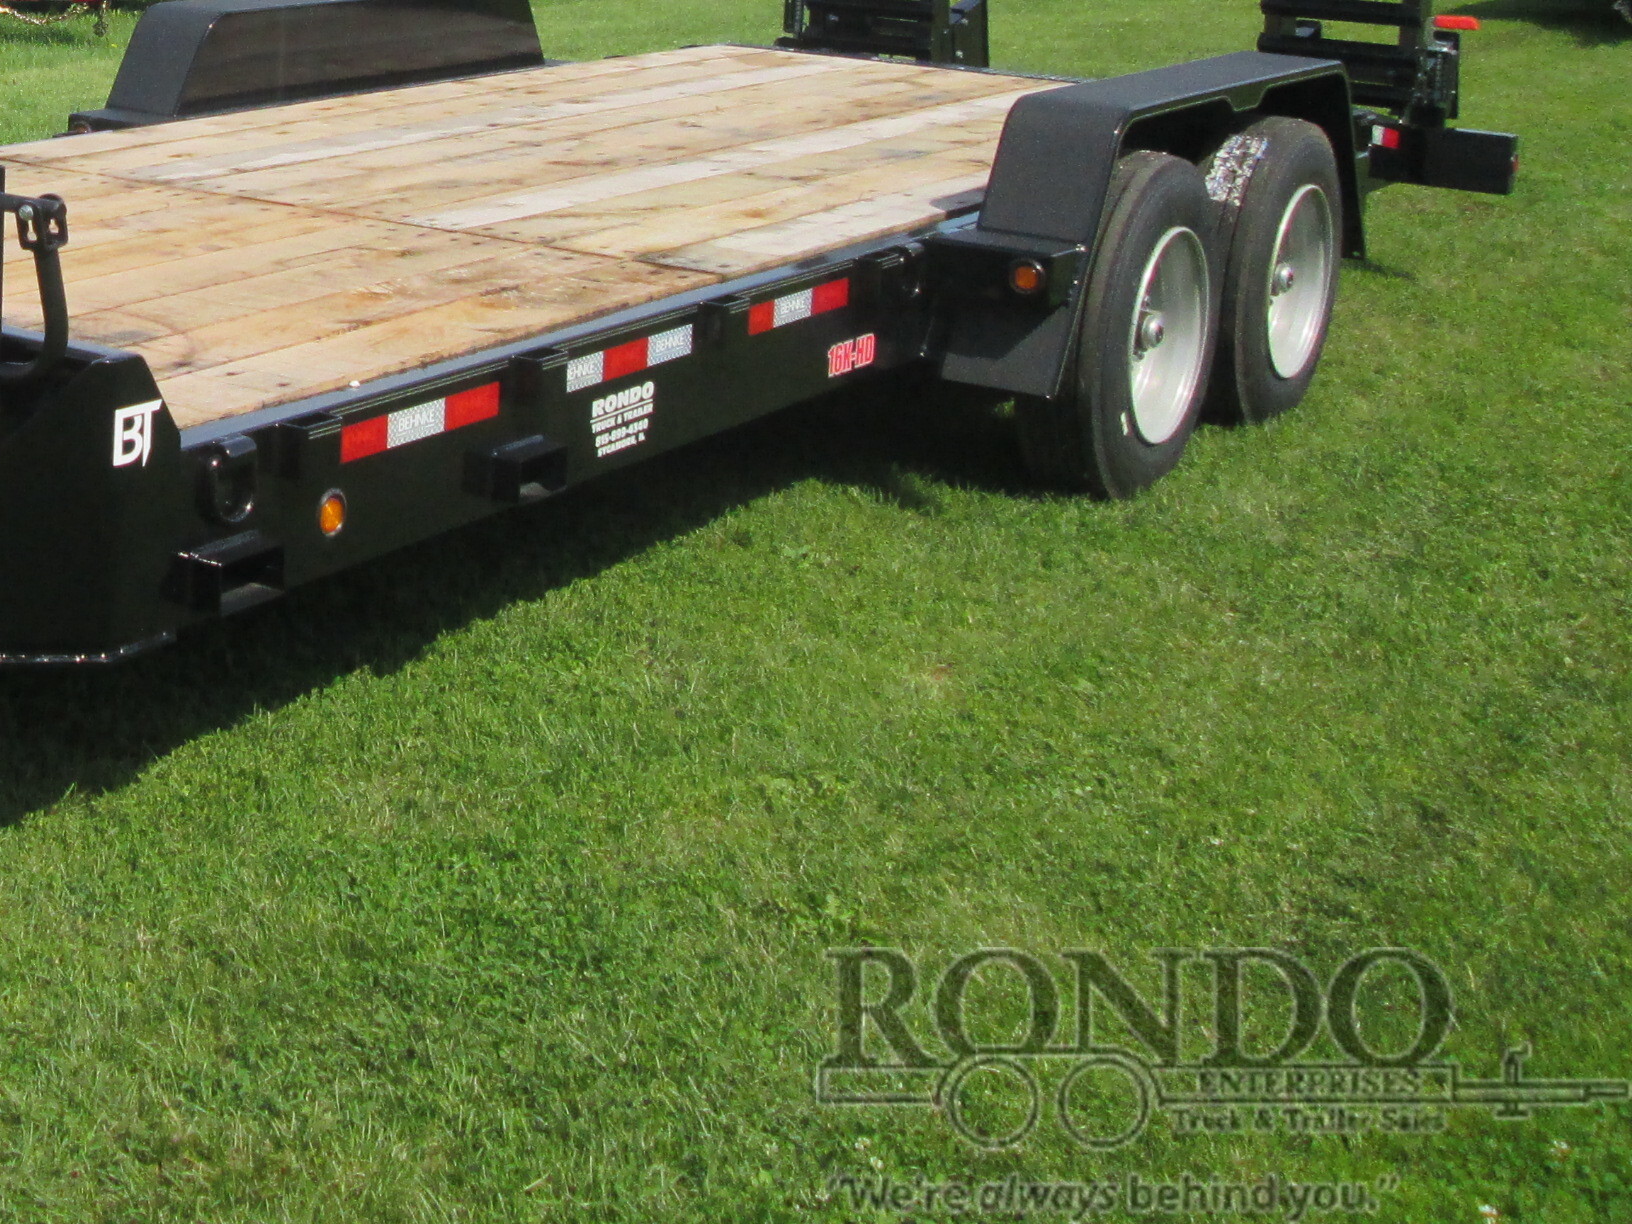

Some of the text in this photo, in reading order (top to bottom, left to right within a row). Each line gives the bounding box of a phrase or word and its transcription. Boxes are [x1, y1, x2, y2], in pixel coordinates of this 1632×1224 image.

[828, 332, 875, 377] 16K-HD
[592, 381, 655, 417] RONDO
[623, 403, 654, 422] TRAILER
[398, 410, 435, 433] BEHNKE
